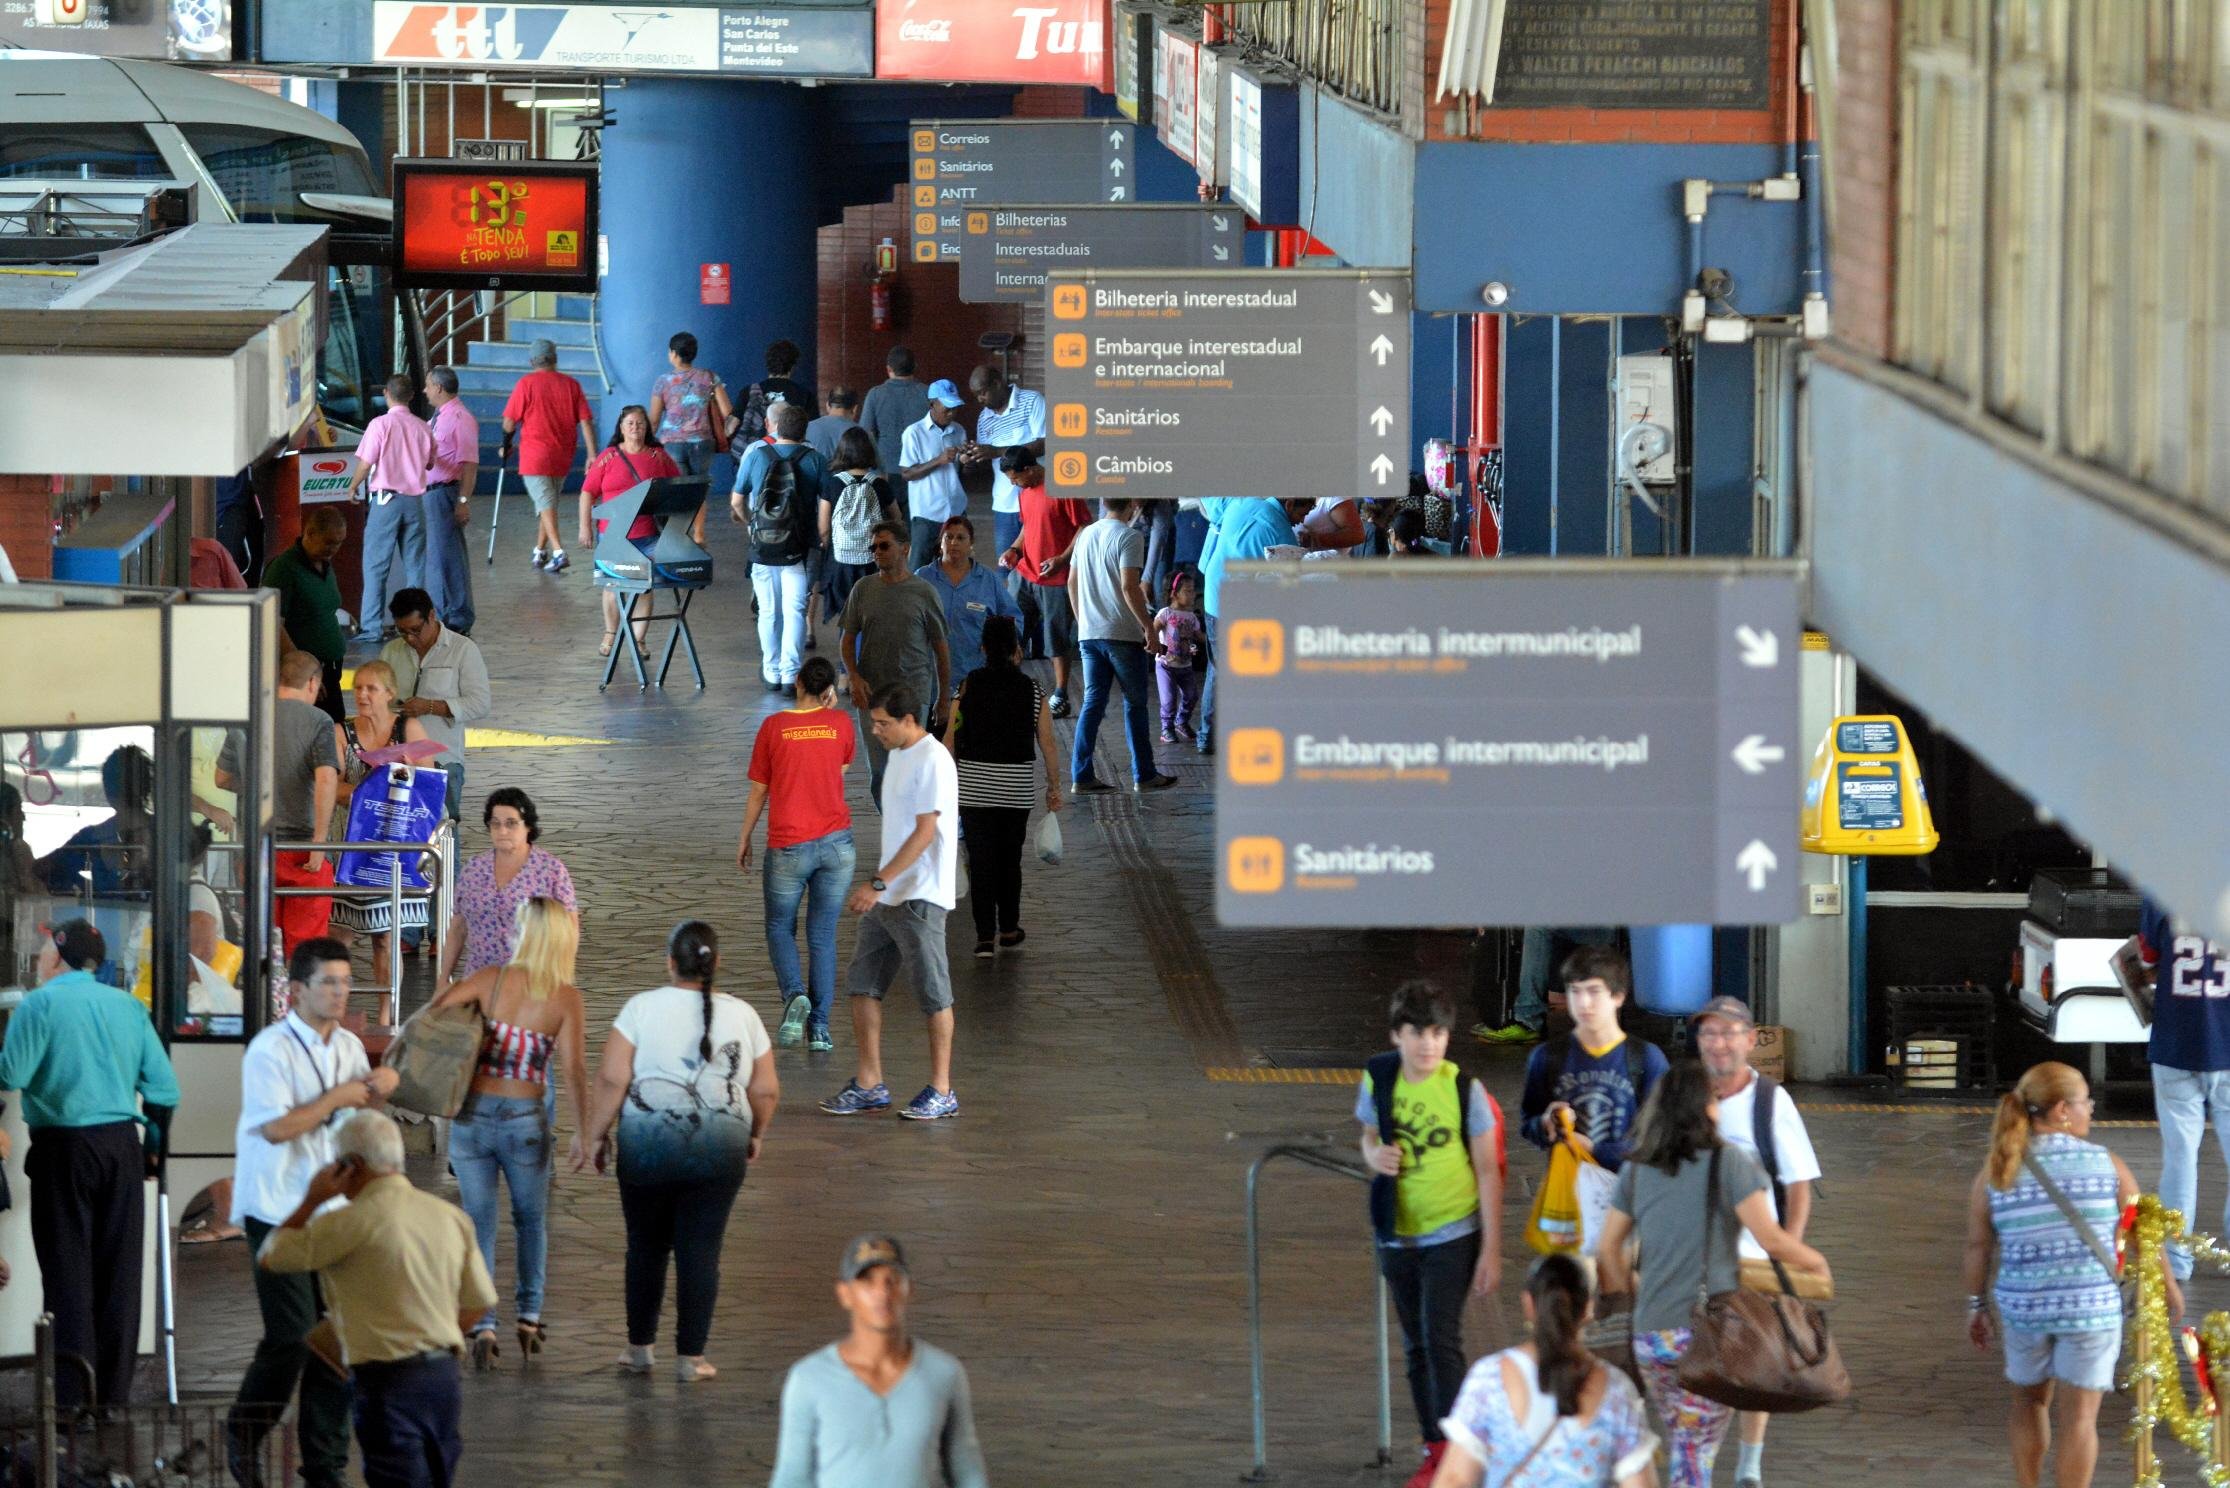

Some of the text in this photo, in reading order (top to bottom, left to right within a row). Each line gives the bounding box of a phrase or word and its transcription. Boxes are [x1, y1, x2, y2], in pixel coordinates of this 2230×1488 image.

[723, 15, 790, 28] Porto Alegre
[723, 29, 780, 40] San Carlos
[723, 42, 799, 54] Punta del Este
[556, 51, 696, 65] TRANSPORTE TURISMO LTDA
[723, 55, 784, 67] Montevideo
[939, 133, 990, 144] Correios
[939, 161, 994, 172] Sanitários
[940, 187, 977, 199] ANTT
[995, 212, 1067, 226] Bilheterias
[473, 227, 526, 247] TENDA
[471, 249, 500, 261] TODO
[995, 242, 1091, 256] Interestaduais
[1095, 288, 1297, 308] Bilheteria interestadual
[1095, 337, 1302, 360] Embarque interestadual
[1095, 359, 1225, 377] e internacional
[1095, 407, 1181, 426] Sanitários
[1095, 455, 1173, 474] Câmbios
[1294, 625, 1642, 662] Bilheteria intermunicipal
[1294, 734, 1649, 772] Embarque intermunicipal
[1294, 842, 1435, 874] Sanitários
